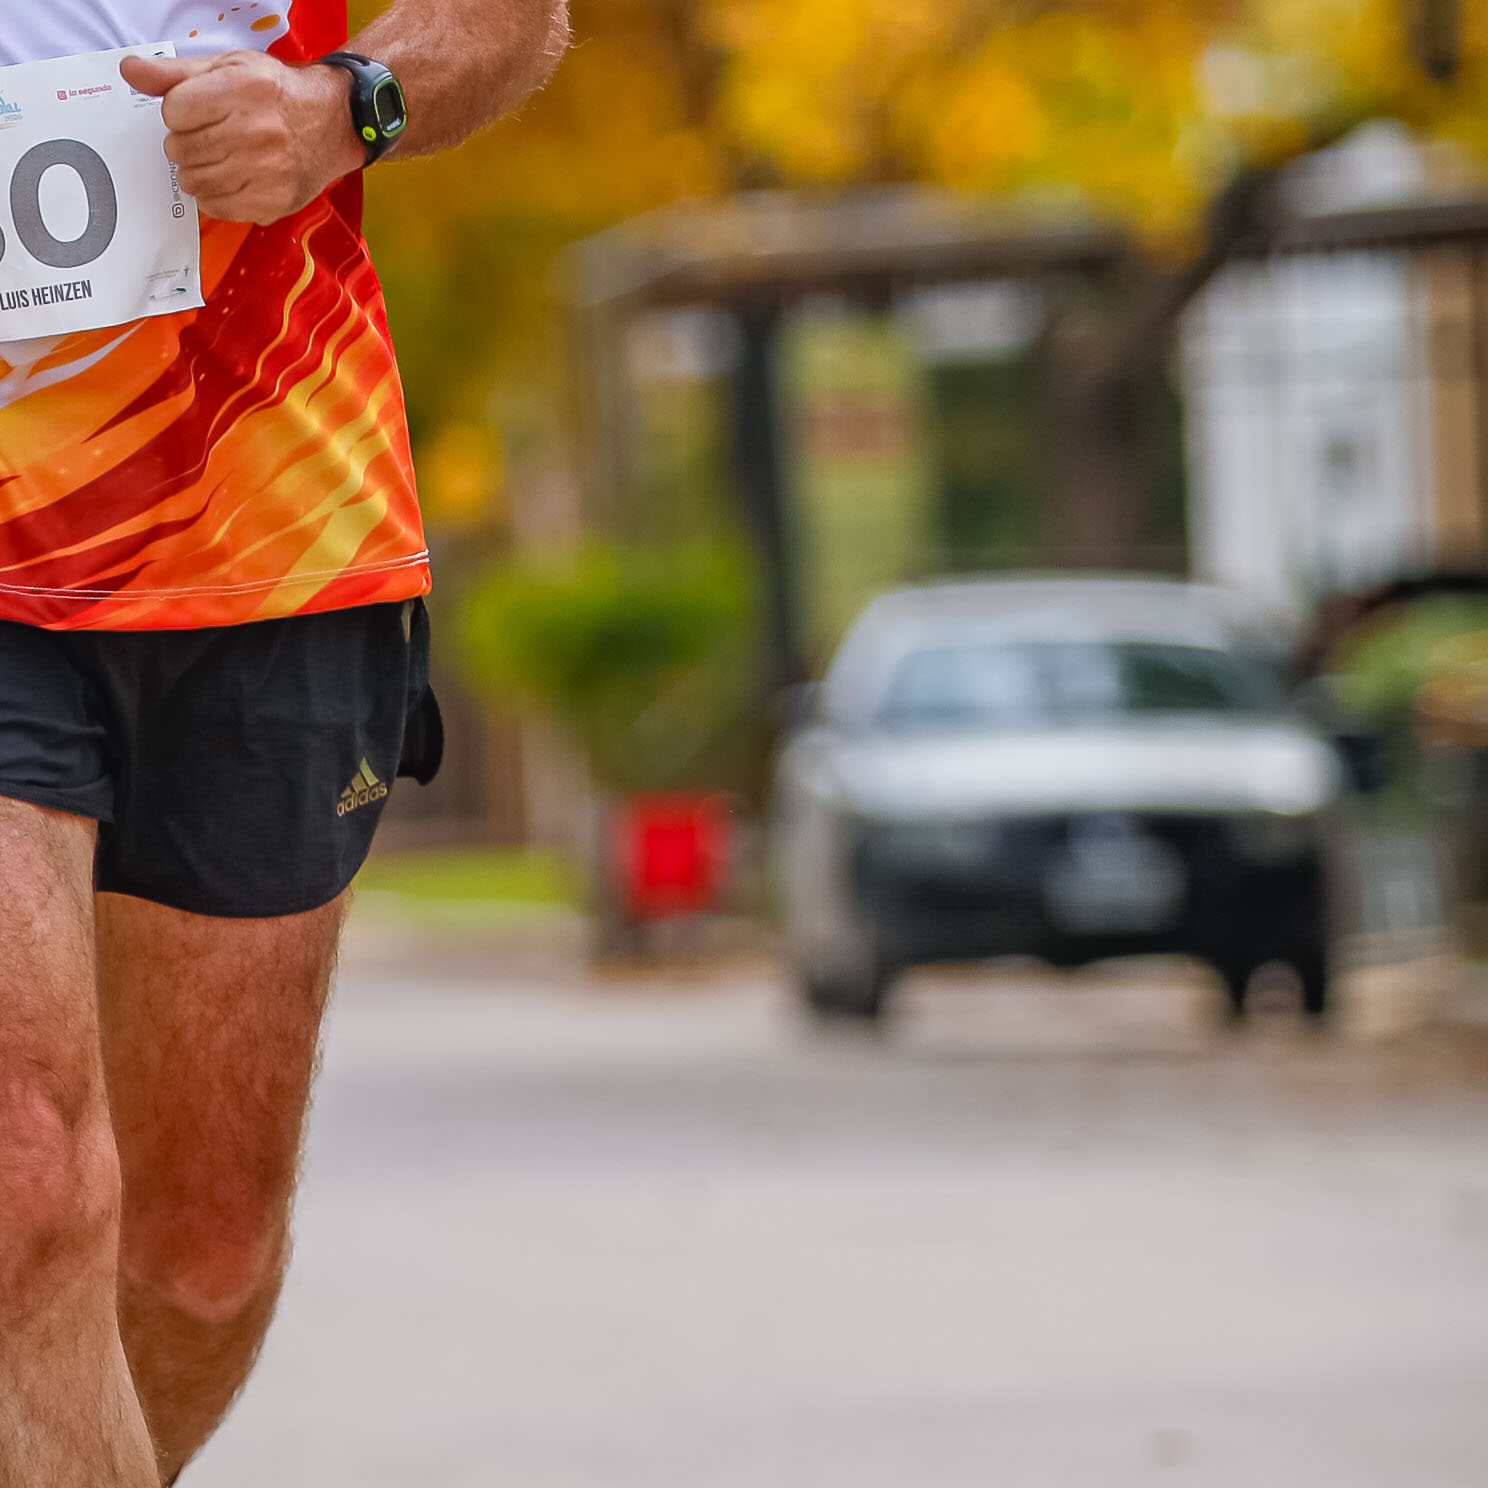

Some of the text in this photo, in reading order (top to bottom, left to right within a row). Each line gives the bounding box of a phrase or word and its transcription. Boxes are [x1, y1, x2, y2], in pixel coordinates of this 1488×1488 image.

[69, 89, 77, 97] la
[79, 84, 112, 95] segunda
[30, 279, 93, 306] HEINZEN
[336, 781, 388, 818] adidas
